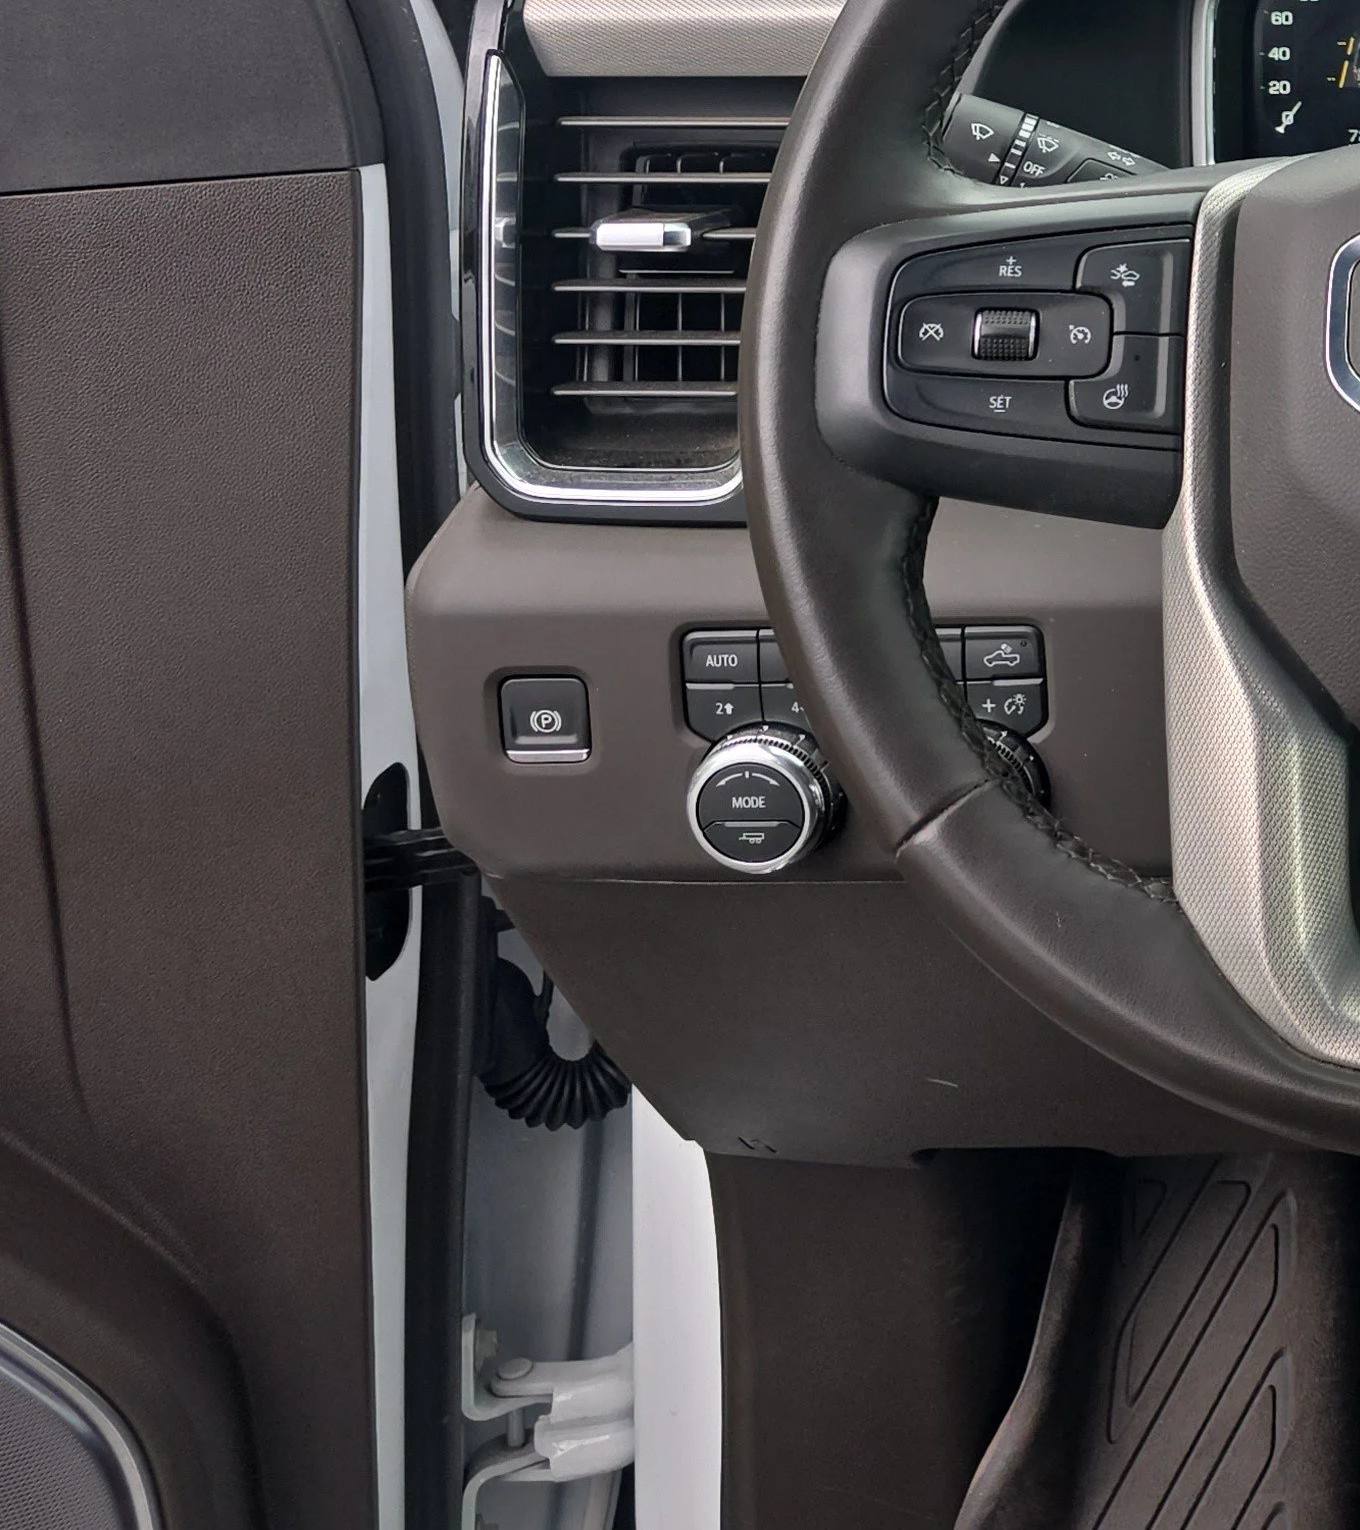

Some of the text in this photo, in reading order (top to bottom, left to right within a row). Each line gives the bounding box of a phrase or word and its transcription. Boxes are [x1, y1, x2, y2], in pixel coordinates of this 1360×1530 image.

[1271, 11, 1293, 25] 60
[1268, 47, 1290, 61] 40
[1268, 80, 1291, 94] 20
[1023, 161, 1046, 177] OFF
[999, 265, 1022, 277] RES
[989, 395, 1012, 409] SET
[705, 653, 738, 668] AUTO
[731, 795, 766, 810] MODE
